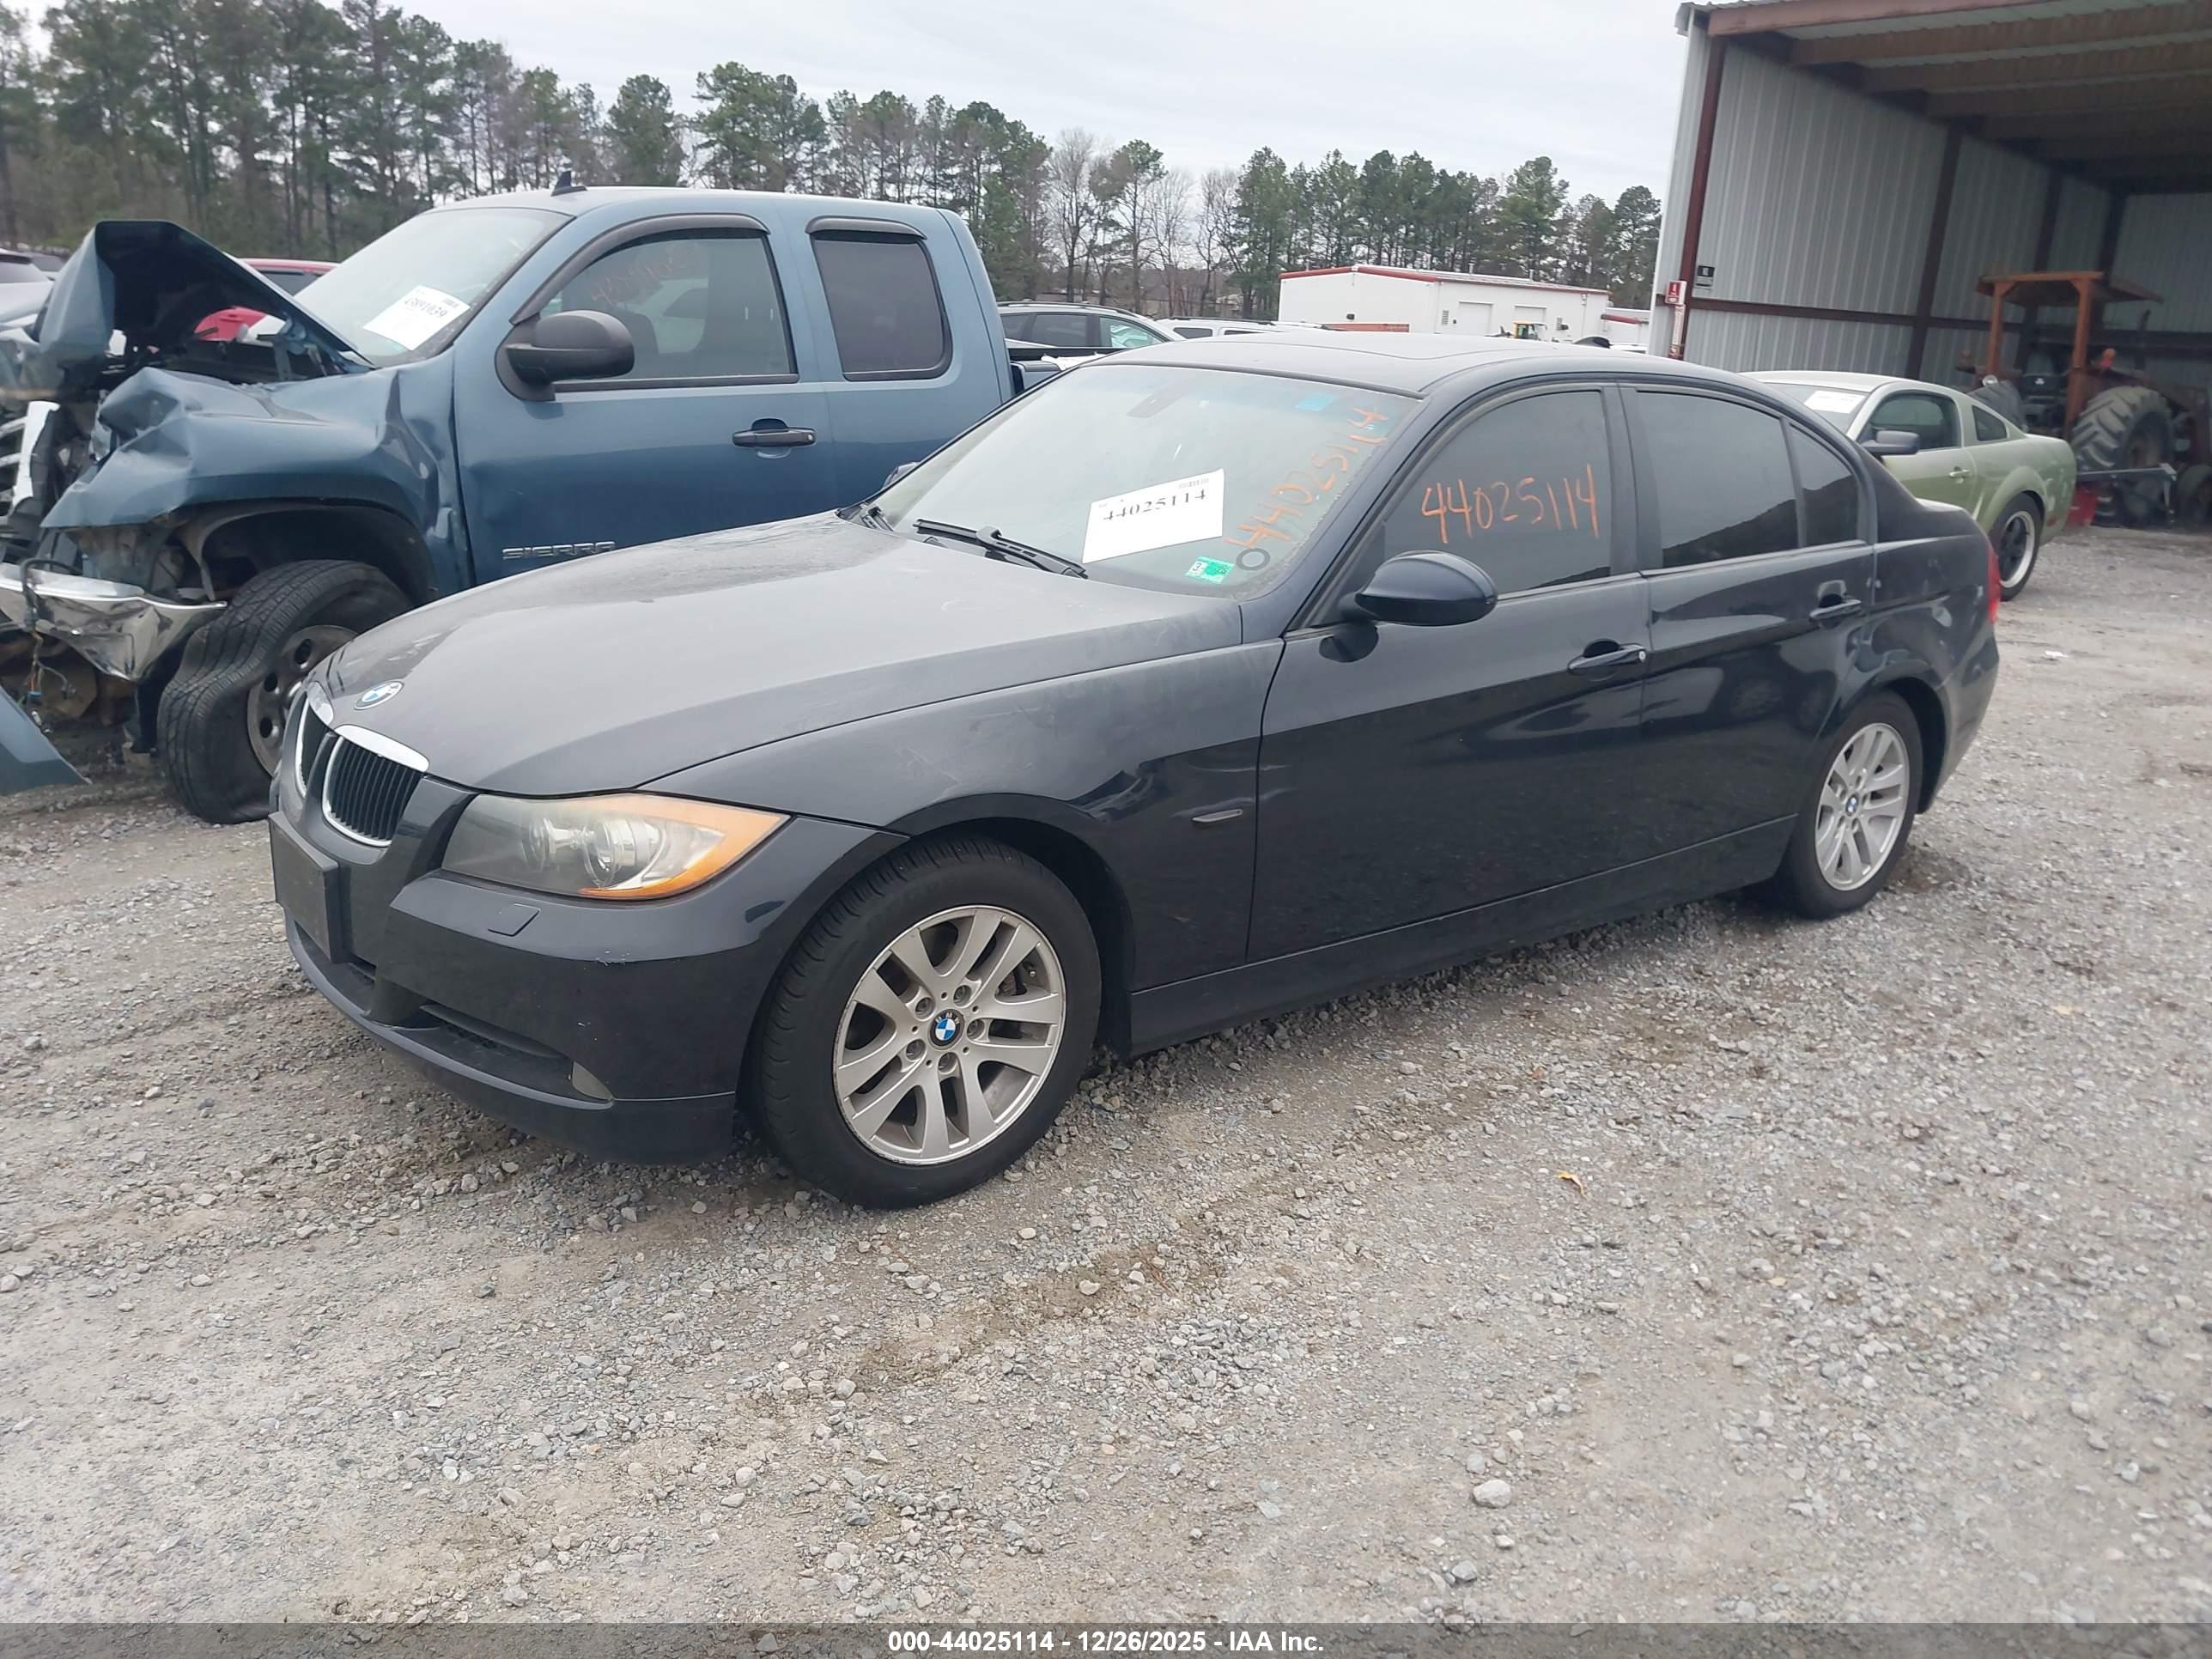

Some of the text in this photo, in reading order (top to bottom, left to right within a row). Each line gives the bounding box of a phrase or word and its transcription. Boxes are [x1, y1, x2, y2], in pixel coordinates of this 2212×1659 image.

[1103, 488, 1207, 520] 44025114
[1224, 407, 1389, 550] 44025114
[1421, 462, 1600, 544] 44025114
[501, 540, 617, 560] SIERRA
